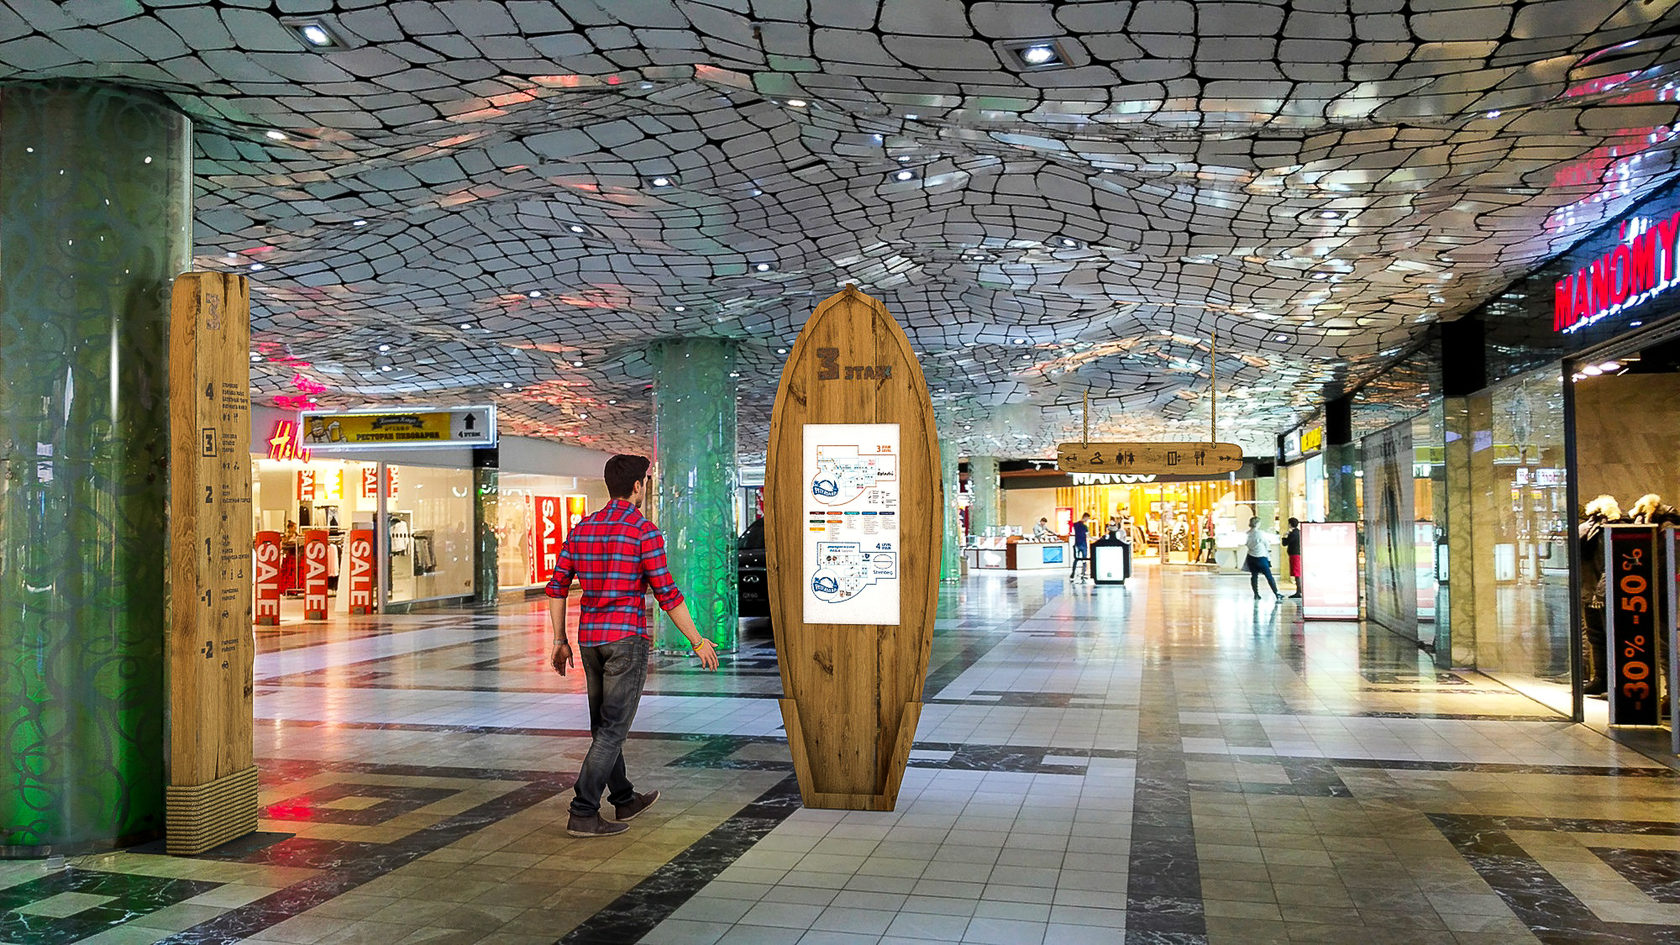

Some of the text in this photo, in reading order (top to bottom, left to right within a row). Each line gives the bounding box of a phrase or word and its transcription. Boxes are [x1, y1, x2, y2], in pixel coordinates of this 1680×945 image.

[816, 347, 892, 380] 3 ЭТАЖ
[205, 382, 214, 400] 4
[205, 433, 213, 452] 3
[205, 485, 213, 504] 2
[301, 469, 313, 501] SALE
[204, 537, 211, 556] 1
[257, 543, 279, 616] SALE
[305, 541, 326, 611] SALE
[350, 540, 370, 606] SALE
[201, 589, 212, 607] -1
[1620, 547, 1650, 711] -30% -50%
[201, 640, 213, 659] -2
